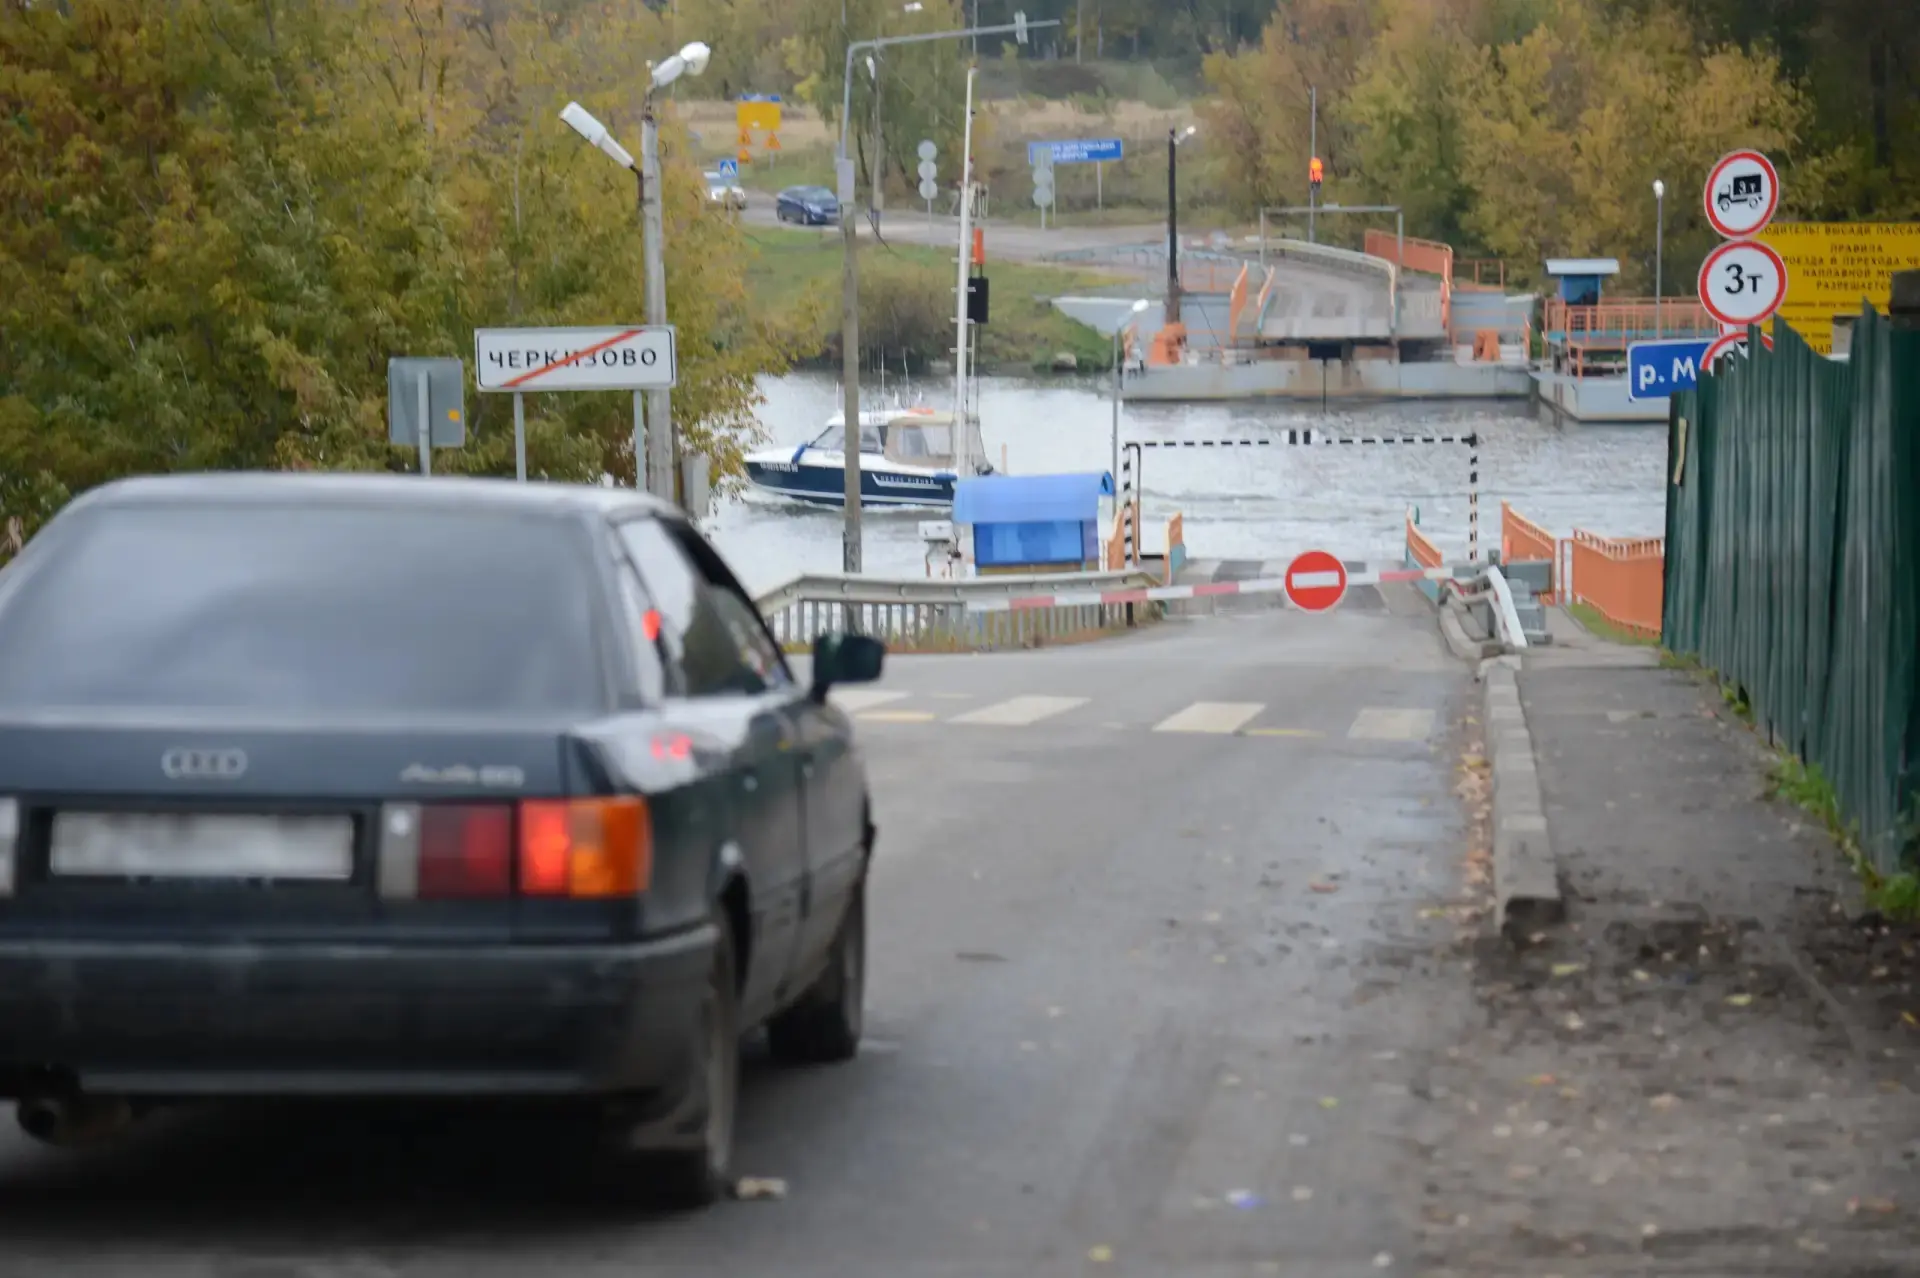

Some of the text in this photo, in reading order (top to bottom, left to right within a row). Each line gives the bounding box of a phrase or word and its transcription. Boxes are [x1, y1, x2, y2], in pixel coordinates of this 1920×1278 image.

[1825, 226, 1870, 236] ВЫСАДИ
[1831, 244, 1883, 253] ПРАВИЛА
[1843, 256, 1900, 265] ПЕРЕХОДА
[1803, 268, 1871, 277] НАПЛАВНОЙ
[1724, 263, 1763, 295] 3т
[489, 348, 657, 369] ЧЕРКИЗОВО
